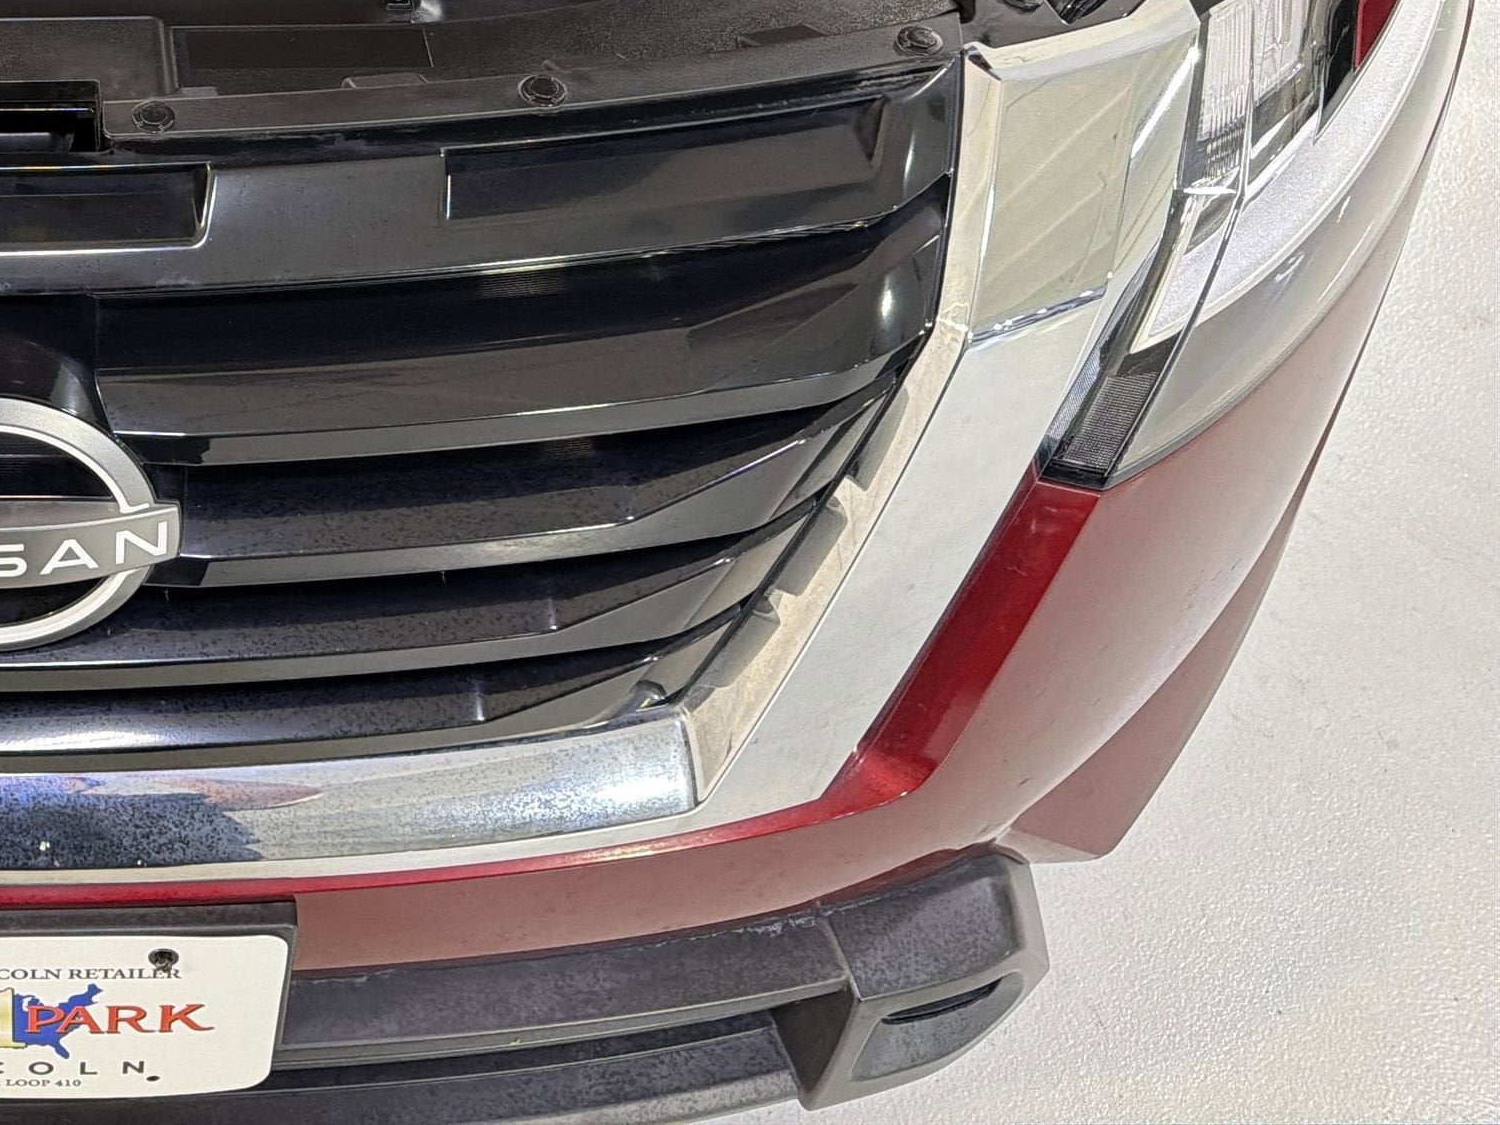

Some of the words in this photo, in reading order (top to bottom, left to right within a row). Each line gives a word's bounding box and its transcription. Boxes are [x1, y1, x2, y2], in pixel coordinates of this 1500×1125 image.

[67, 968, 183, 980] RETAILER
[25, 1003, 216, 1035] PARK
[5, 1079, 51, 1087] LOOP
[54, 1079, 82, 1087] 410
